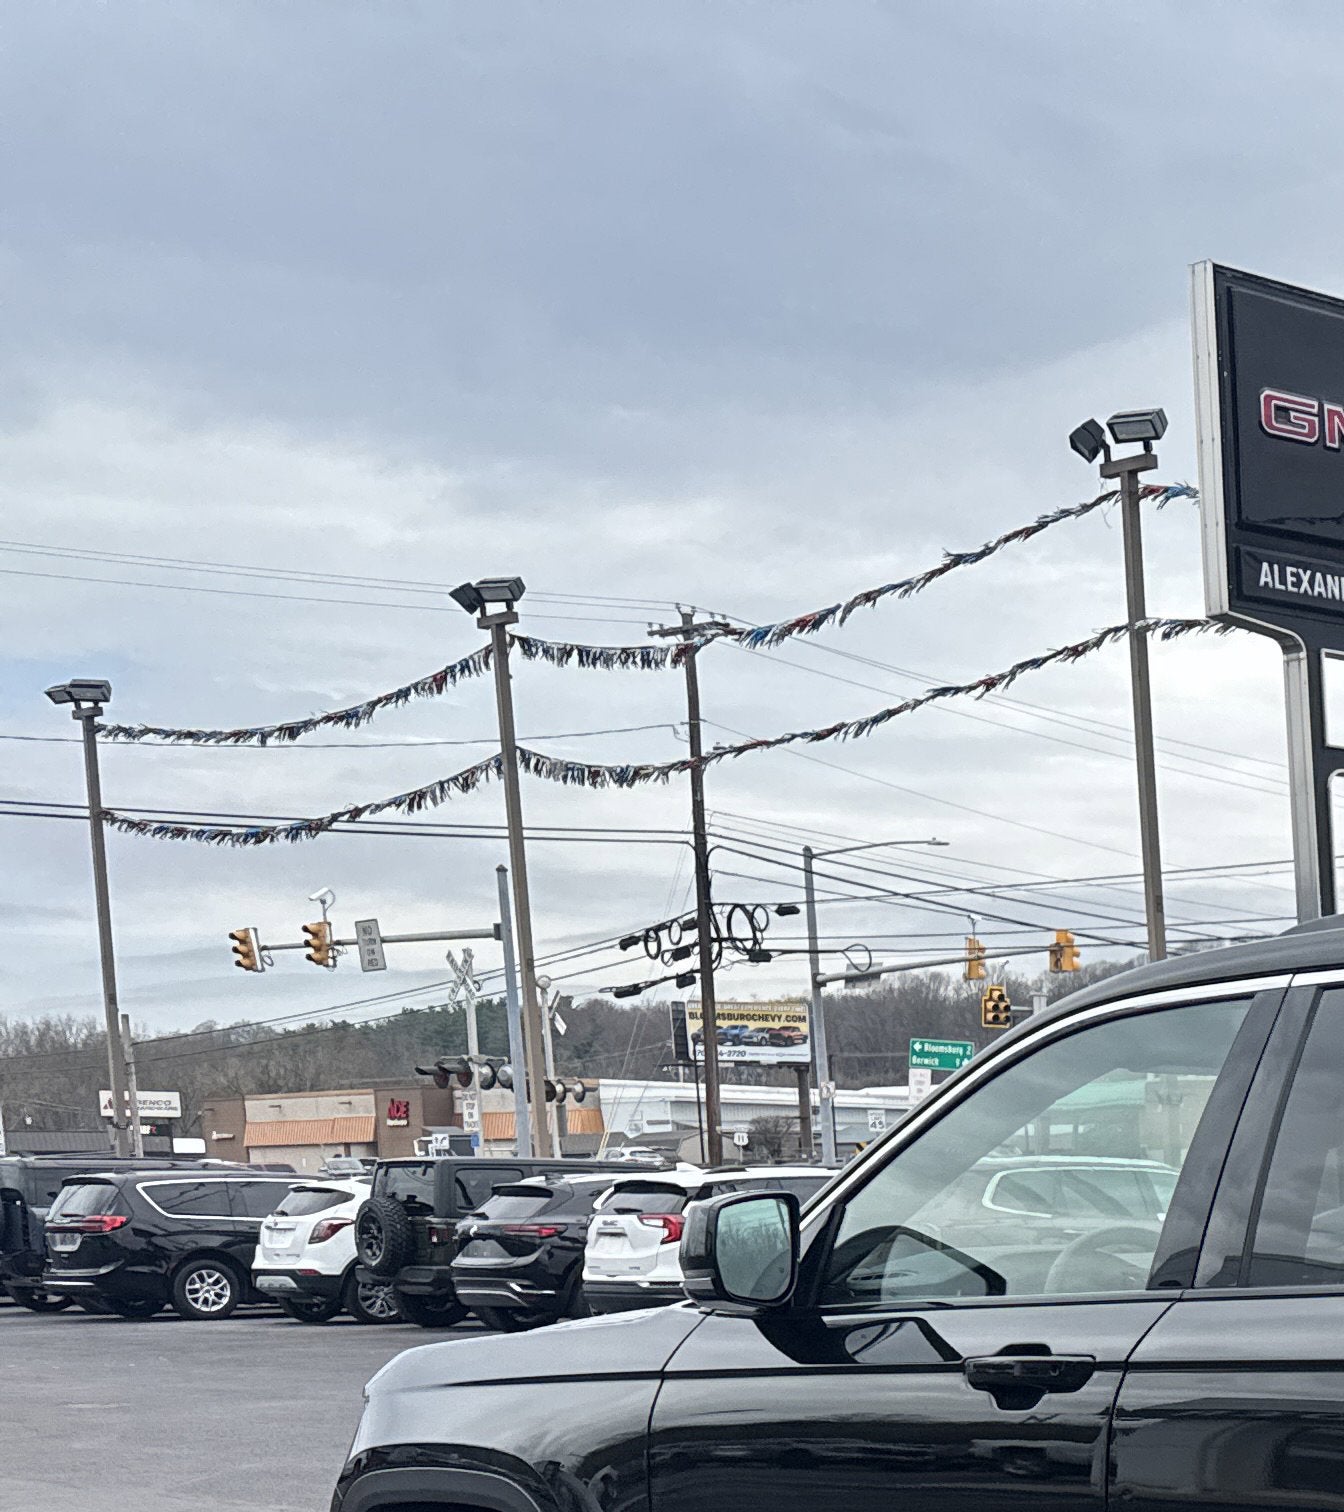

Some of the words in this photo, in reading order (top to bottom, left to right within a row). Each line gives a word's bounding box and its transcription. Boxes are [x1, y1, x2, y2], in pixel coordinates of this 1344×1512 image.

[924, 1043, 964, 1056] Bloomsburg
[966, 1045, 972, 1055] 2
[911, 1055, 939, 1066] Berwick
[870, 1120, 885, 1130] 45
